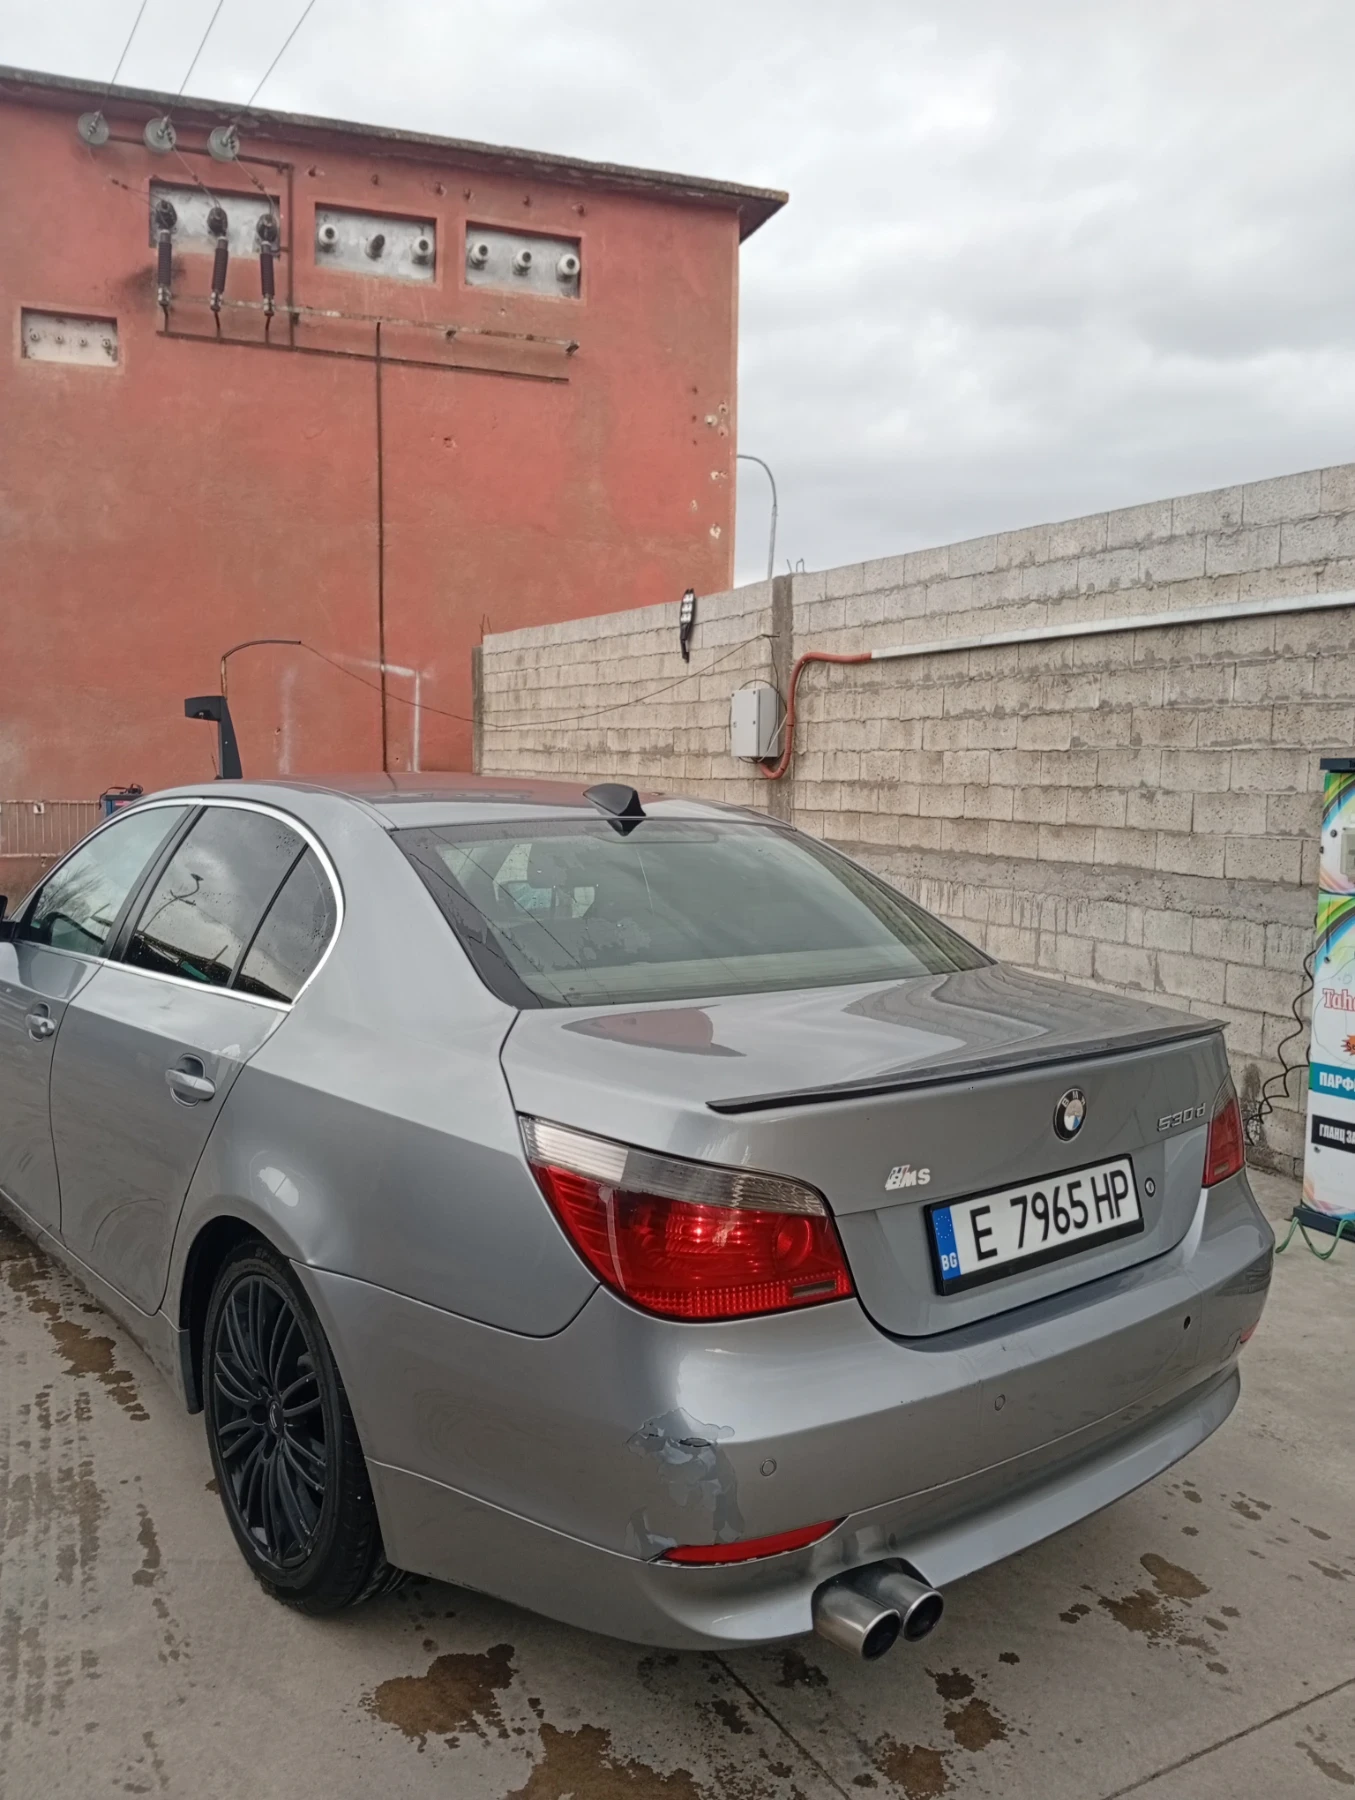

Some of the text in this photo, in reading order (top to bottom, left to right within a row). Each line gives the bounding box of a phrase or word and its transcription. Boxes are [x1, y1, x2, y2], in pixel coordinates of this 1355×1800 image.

[1319, 1071, 1355, 1092] ПАРФ
[1319, 1123, 1346, 1144] ГЛАНЦ
[969, 1169, 1128, 1262] E 7965 HP
[940, 1252, 958, 1272] BG
